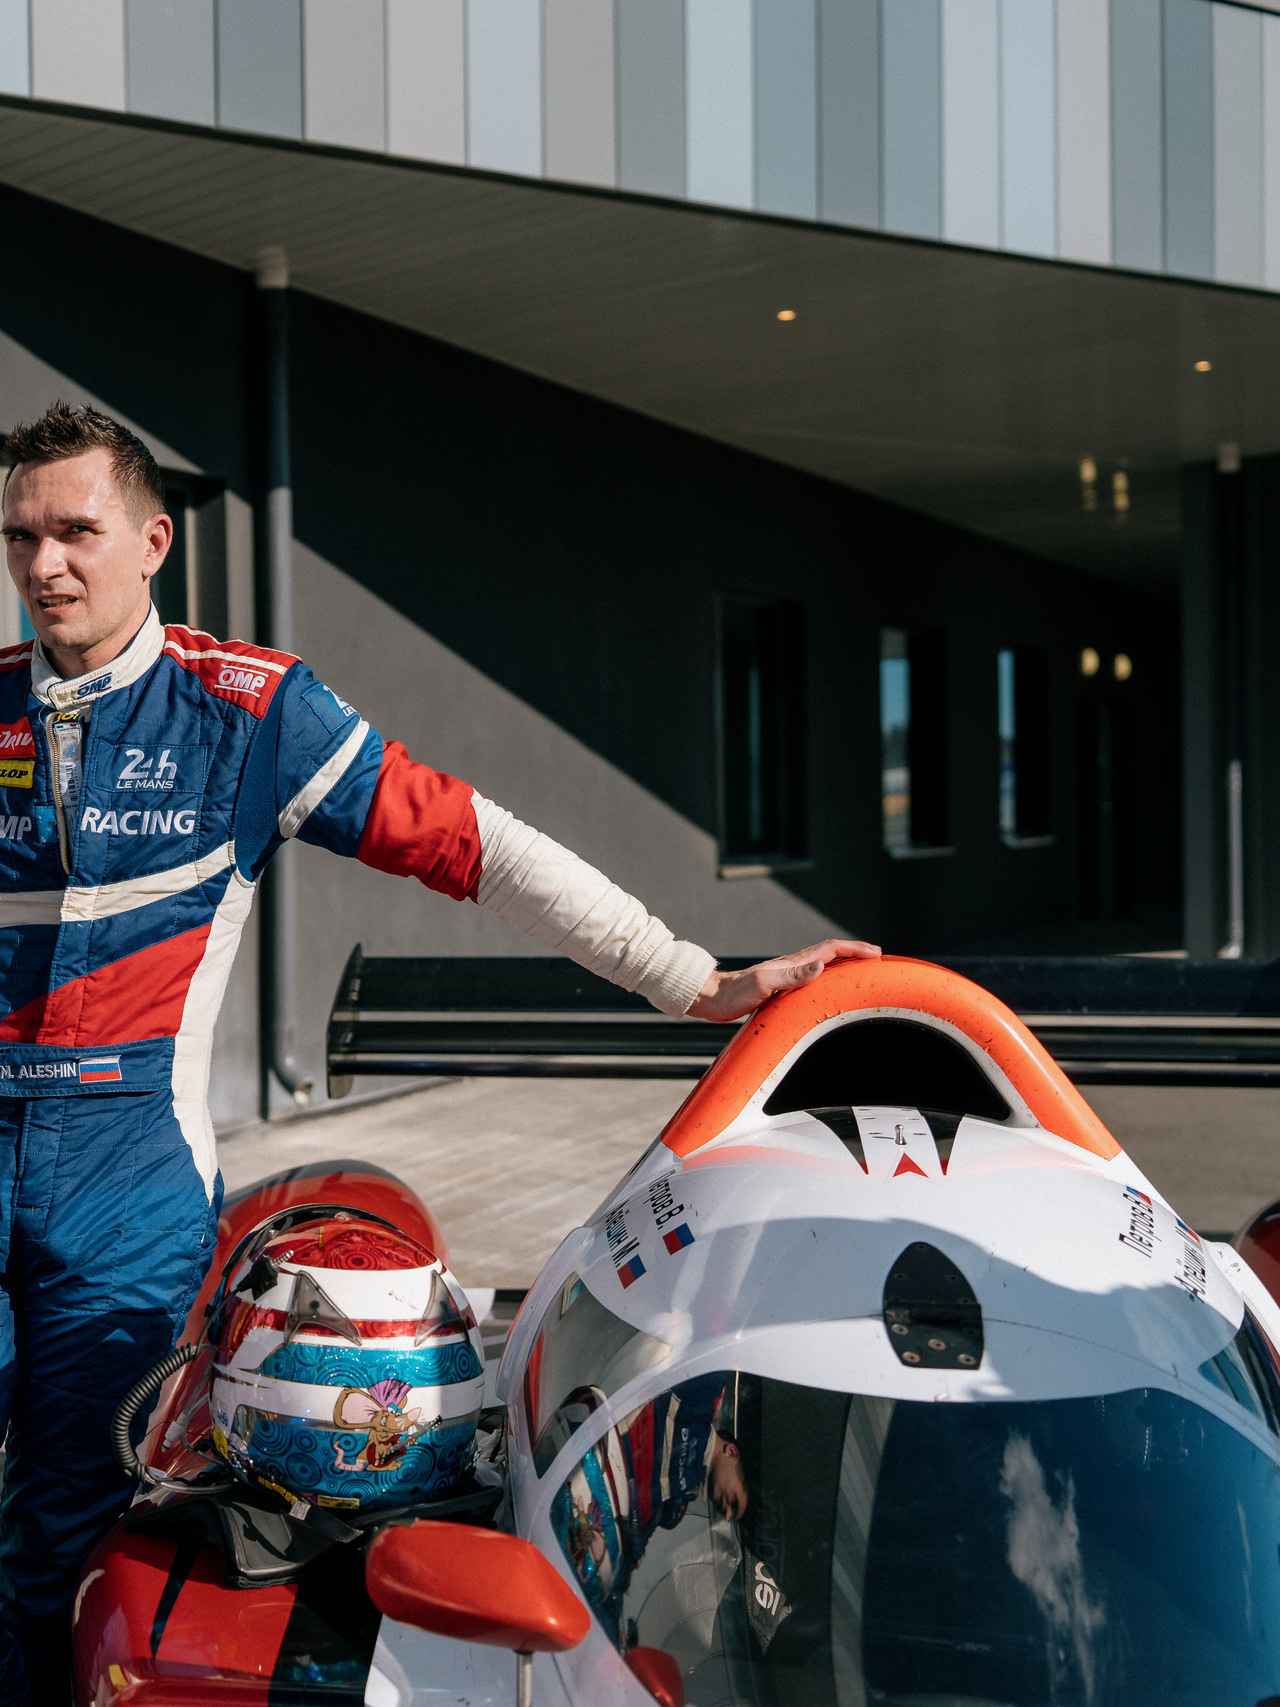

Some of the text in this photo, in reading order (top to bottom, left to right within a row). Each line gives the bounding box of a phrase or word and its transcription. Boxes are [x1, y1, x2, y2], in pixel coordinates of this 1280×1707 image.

[78, 676, 112, 696] OMP
[218, 669, 265, 692] OMP
[116, 780, 174, 789] LE MANS
[81, 806, 196, 835] RACING
[19, 1062, 77, 1080] ALESHIN
[1118, 1206, 1162, 1258] Петров
